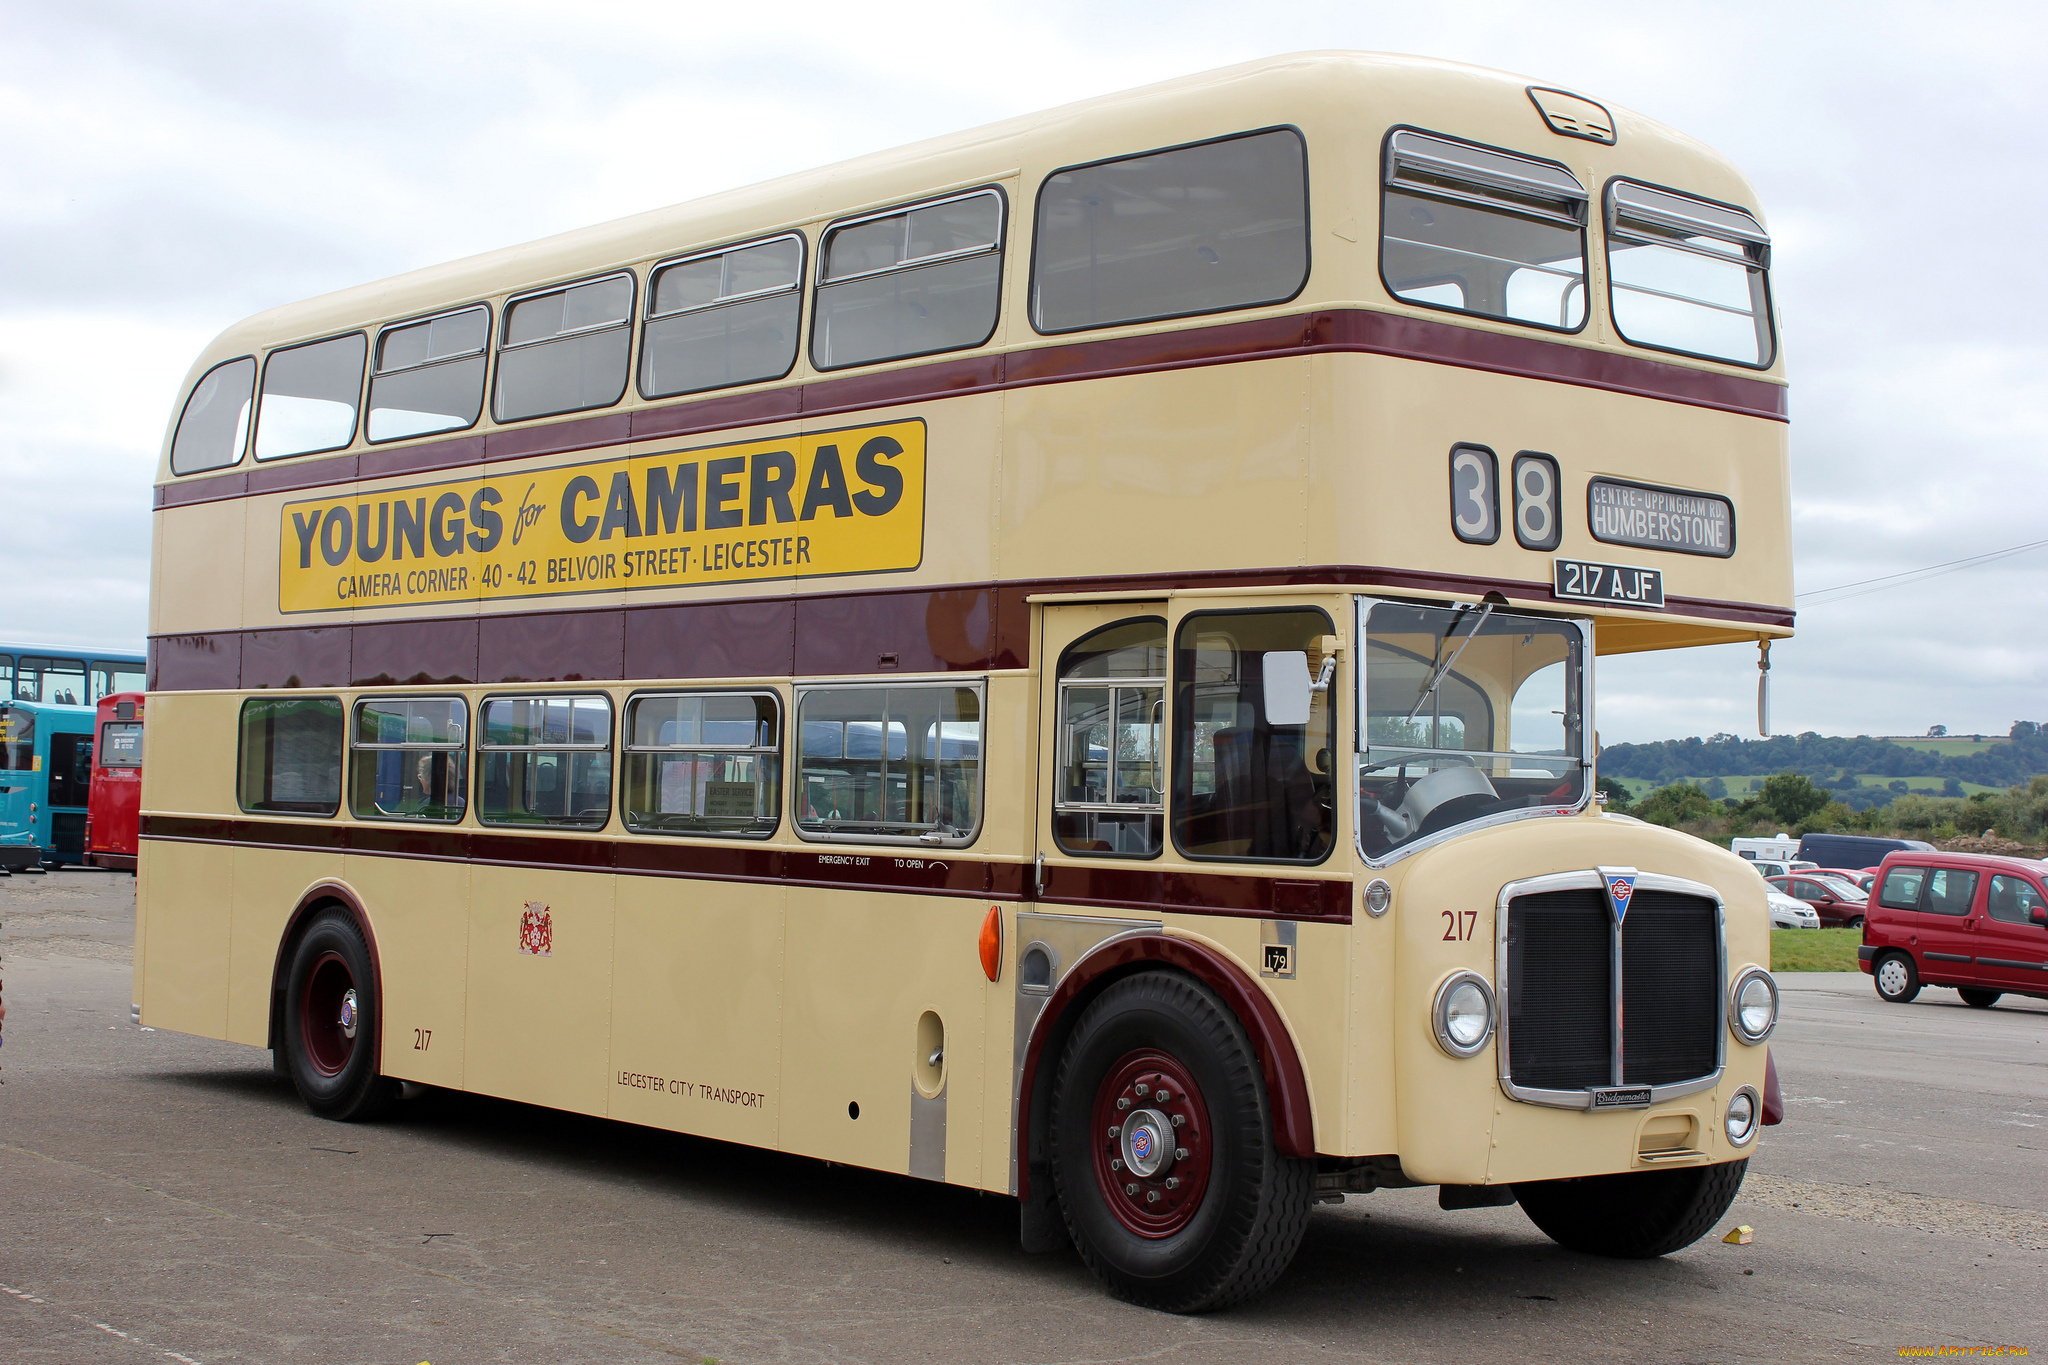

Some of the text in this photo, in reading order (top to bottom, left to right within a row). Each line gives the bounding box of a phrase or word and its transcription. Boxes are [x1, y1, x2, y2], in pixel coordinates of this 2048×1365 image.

[291, 435, 905, 569] YOUNGS for CAMERAS
[1593, 504, 1726, 549] HUMBERSTONE
[337, 572, 402, 600] CAMERA
[407, 566, 468, 595] CORNER
[481, 563, 502, 589] 40
[516, 560, 537, 586] 42
[547, 553, 617, 584] BELVOIR
[702, 535, 811, 572] LEICESTER
[1564, 563, 1655, 600] 217 AJF
[709, 786, 730, 796] EASTER
[818, 854, 871, 866] EMERGENCY EXIT
[894, 858, 924, 869] TO OPEN
[1441, 910, 1478, 941] 217
[1267, 954, 1286, 969] 179
[414, 1027, 432, 1051] 217
[617, 1070, 765, 1109] LEICESTER CITY TRANSPORT
